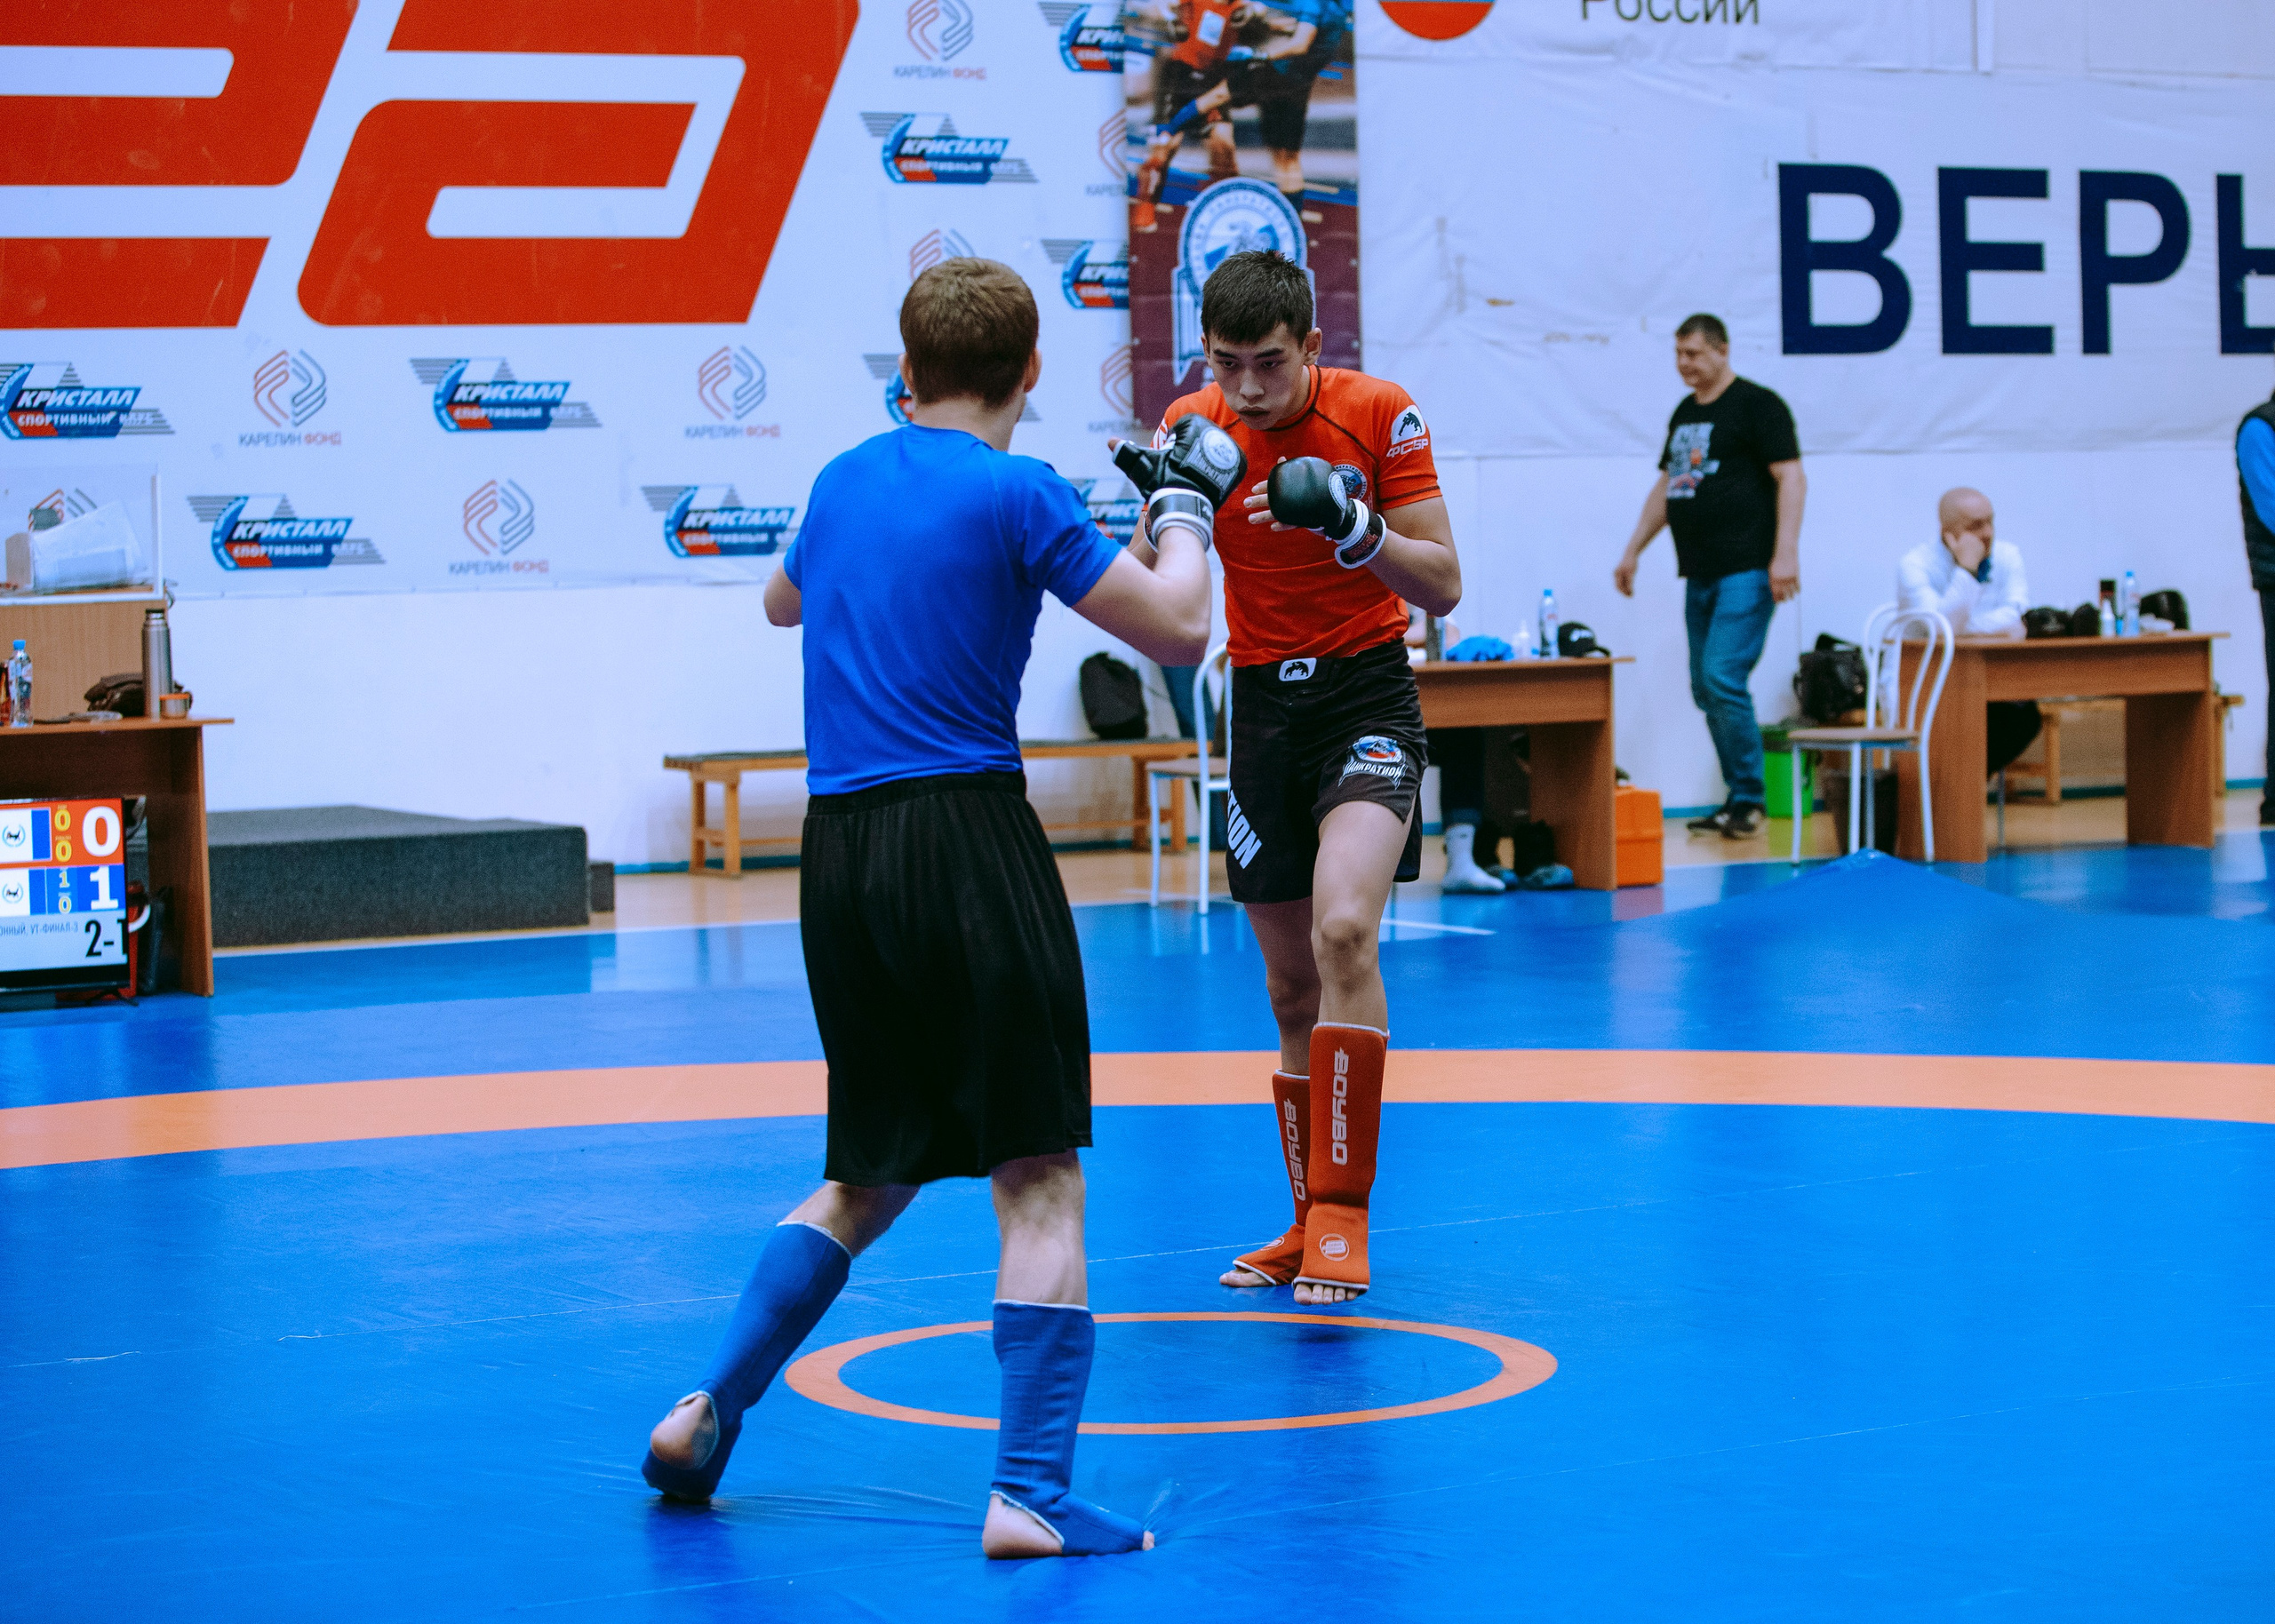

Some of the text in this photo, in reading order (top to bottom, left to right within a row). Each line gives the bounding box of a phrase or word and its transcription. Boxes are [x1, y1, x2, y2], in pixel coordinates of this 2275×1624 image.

[900, 139, 1005, 155] КРИСТАЛЛ
[17, 390, 135, 408] КРИСТАЛЛ
[453, 384, 564, 401] КРИСТАЛЛ
[18, 412, 116, 426] СПОРТИВНЫЙ
[238, 430, 342, 448] КАРЕЛИН ФОНД
[1386, 438, 1429, 458] ФСБР
[232, 521, 347, 540] КРИСТАЛЛ
[54, 808, 71, 832] 0
[82, 806, 121, 857] 0
[55, 840, 72, 863] 0
[59, 871, 70, 888] 1
[90, 866, 119, 911] 1
[58, 896, 72, 914] 0
[1331, 1047, 1349, 1166] BOYBO
[1283, 1098, 1306, 1201] BOYBO
